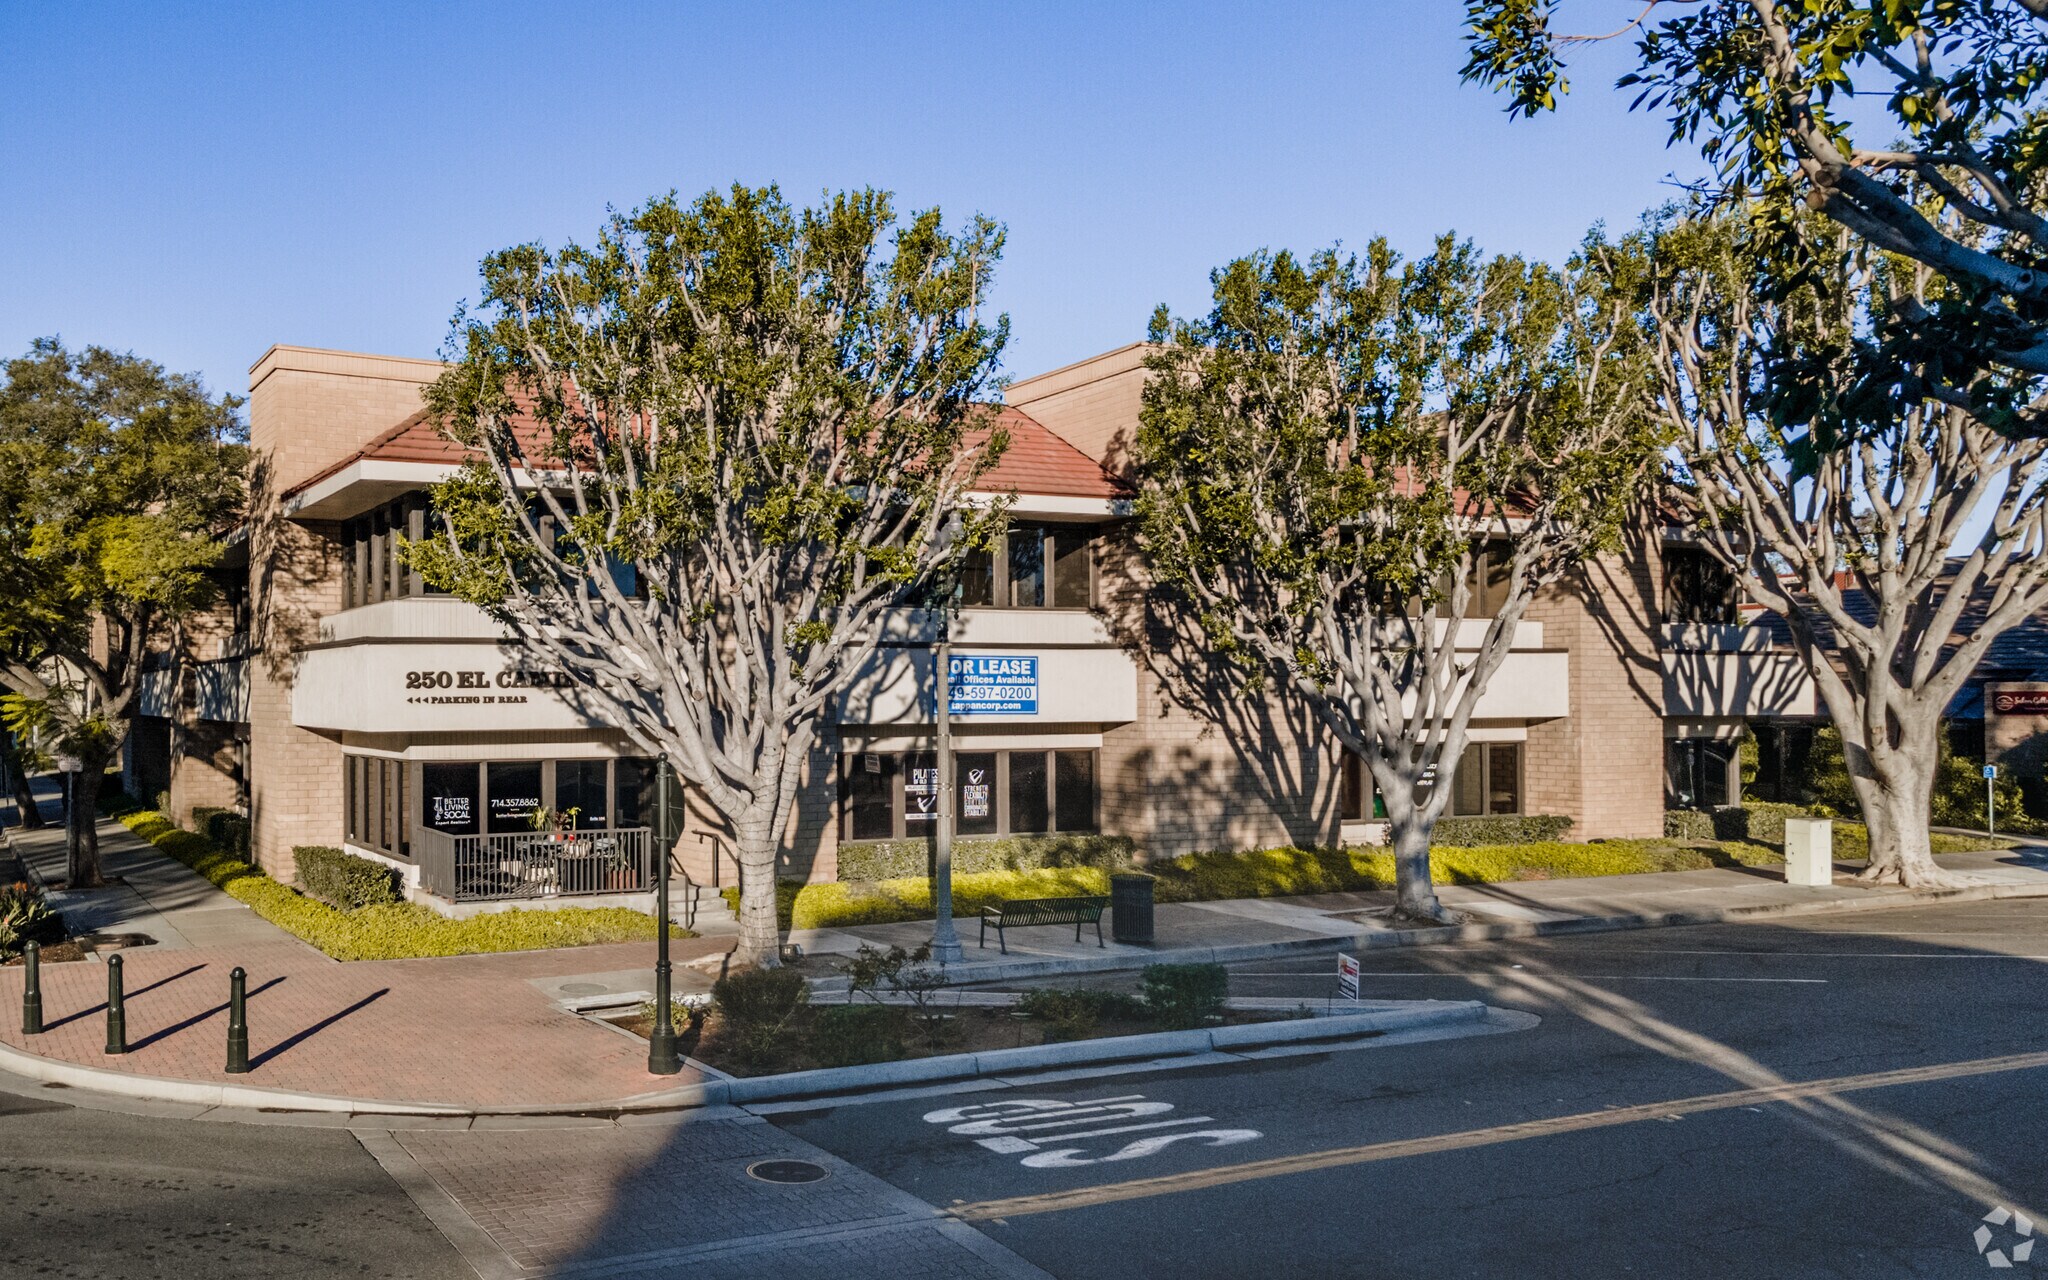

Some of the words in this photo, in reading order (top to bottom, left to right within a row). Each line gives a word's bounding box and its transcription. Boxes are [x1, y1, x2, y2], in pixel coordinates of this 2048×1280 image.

[950, 660, 974, 674] OR
[979, 660, 1031, 674] LEASE
[405, 671, 453, 689] 250
[456, 671, 491, 688] EL
[963, 676, 994, 684] Offices
[996, 676, 1035, 684] Available
[948, 687, 1032, 699] 49-597-0200
[430, 696, 480, 704] PARKING
[482, 696, 495, 704] IN
[498, 696, 528, 704] REAR
[951, 702, 1021, 711] tappancorp.com
[491, 798, 539, 807] 714.357.8862
[443, 811, 470, 819] SOCAL
